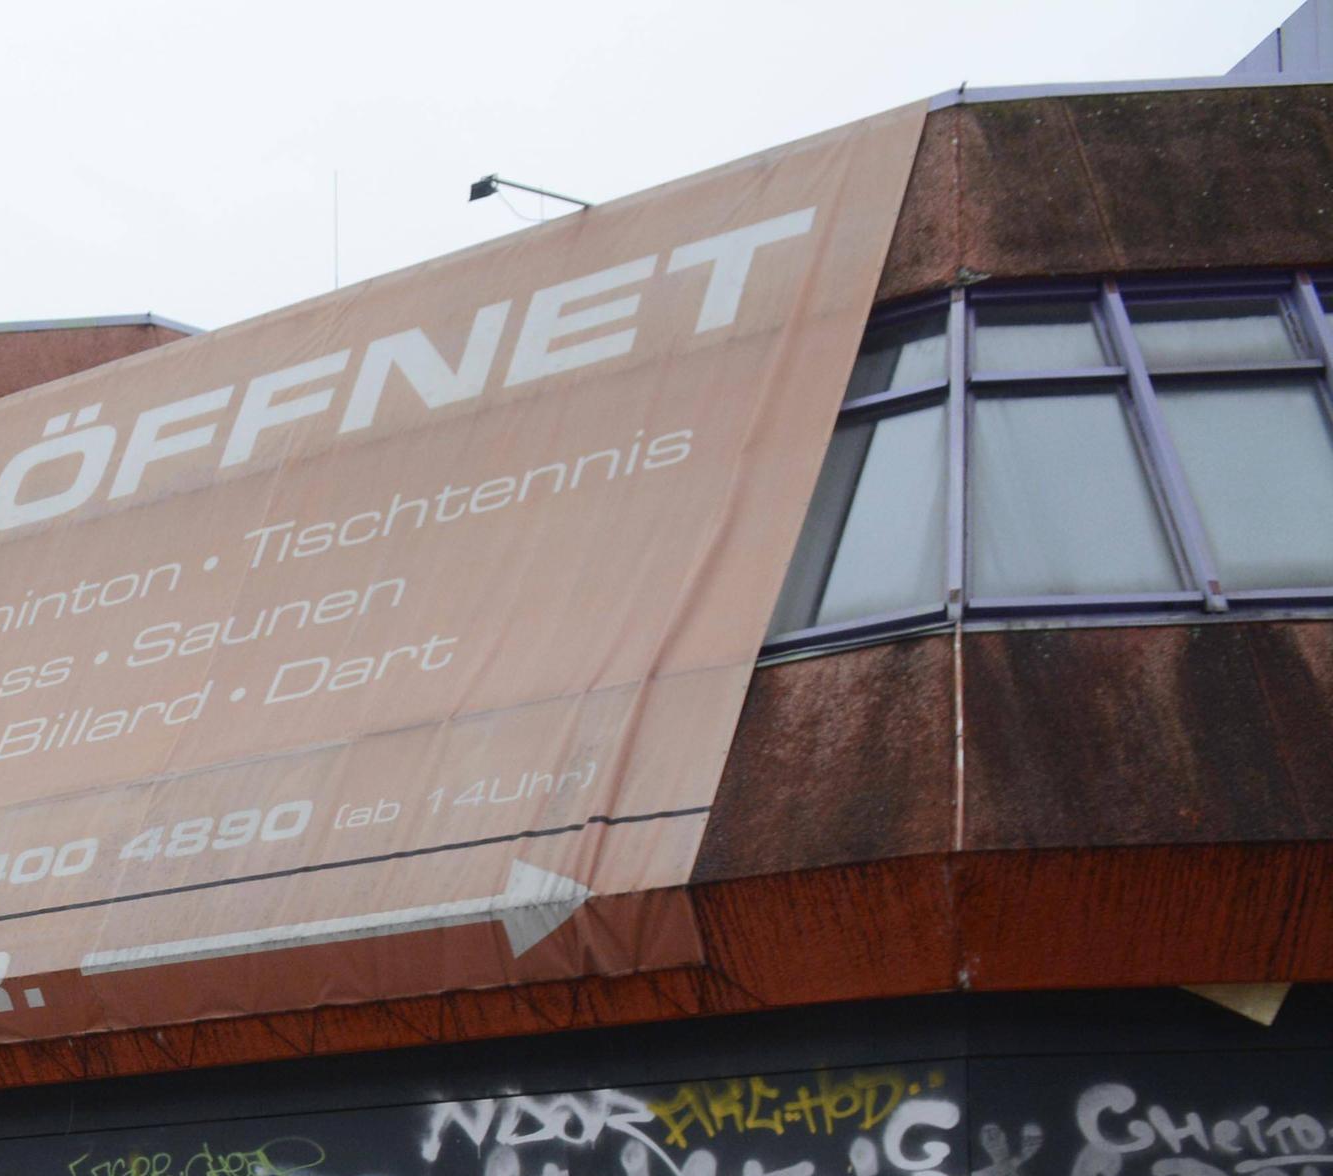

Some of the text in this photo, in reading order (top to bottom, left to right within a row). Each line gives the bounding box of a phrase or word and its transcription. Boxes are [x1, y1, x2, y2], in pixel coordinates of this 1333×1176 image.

[244, 429, 694, 569] Tischtennis
[127, 577, 407, 667] Saunen
[264, 636, 459, 706] Dart
[119, 801, 314, 864] 4890
